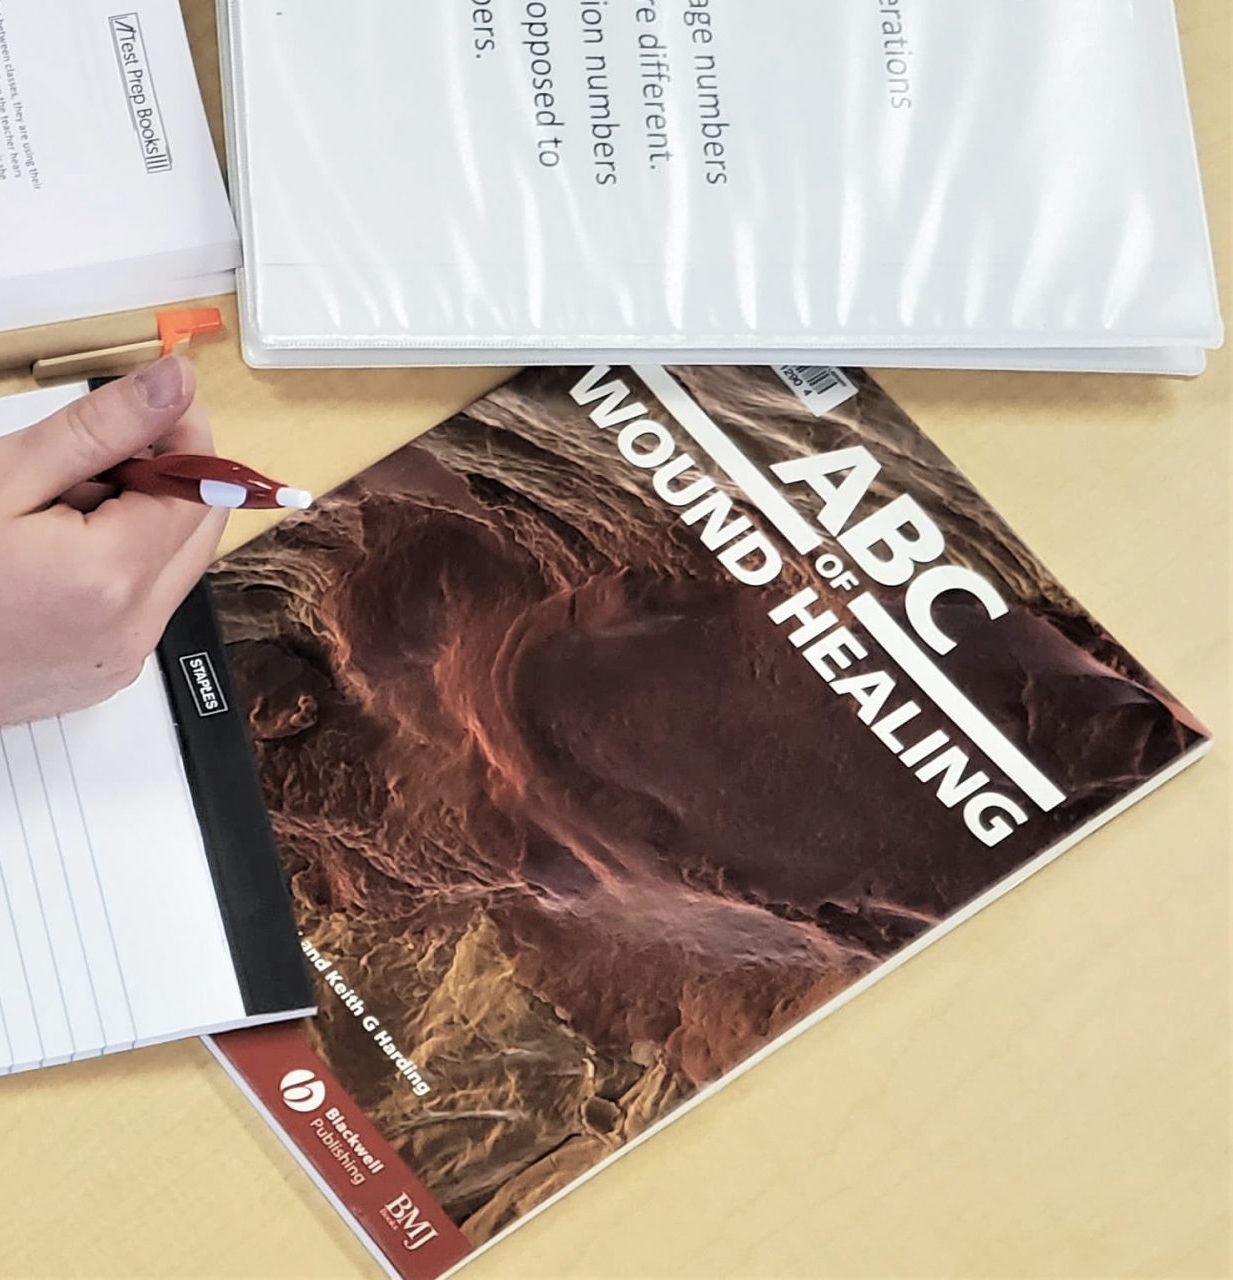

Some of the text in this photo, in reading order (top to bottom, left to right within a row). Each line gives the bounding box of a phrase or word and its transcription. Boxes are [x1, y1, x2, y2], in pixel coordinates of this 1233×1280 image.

[3, 63, 18, 100] classes,
[118, 31, 161, 155] Test Prep Books
[519, 1, 565, 126] opposed
[12, 101, 24, 123] they
[17, 124, 28, 140] are
[584, 55, 620, 185] numbers
[637, 33, 672, 170] different.
[693, 54, 730, 184] numbers
[21, 141, 35, 167] using
[27, 167, 41, 189] their
[537, 136, 563, 167] to
[769, 445, 1009, 656] ABC
[815, 553, 860, 592] OF
[569, 365, 1029, 848] WOUND HEALING
[189, 658, 218, 710] STAPLES
[300, 939, 431, 1097] and Keith G Harding
[310, 1117, 367, 1186] Publishing
[324, 1107, 385, 1175] Blackwell
[383, 1191, 438, 1252] BMJ
